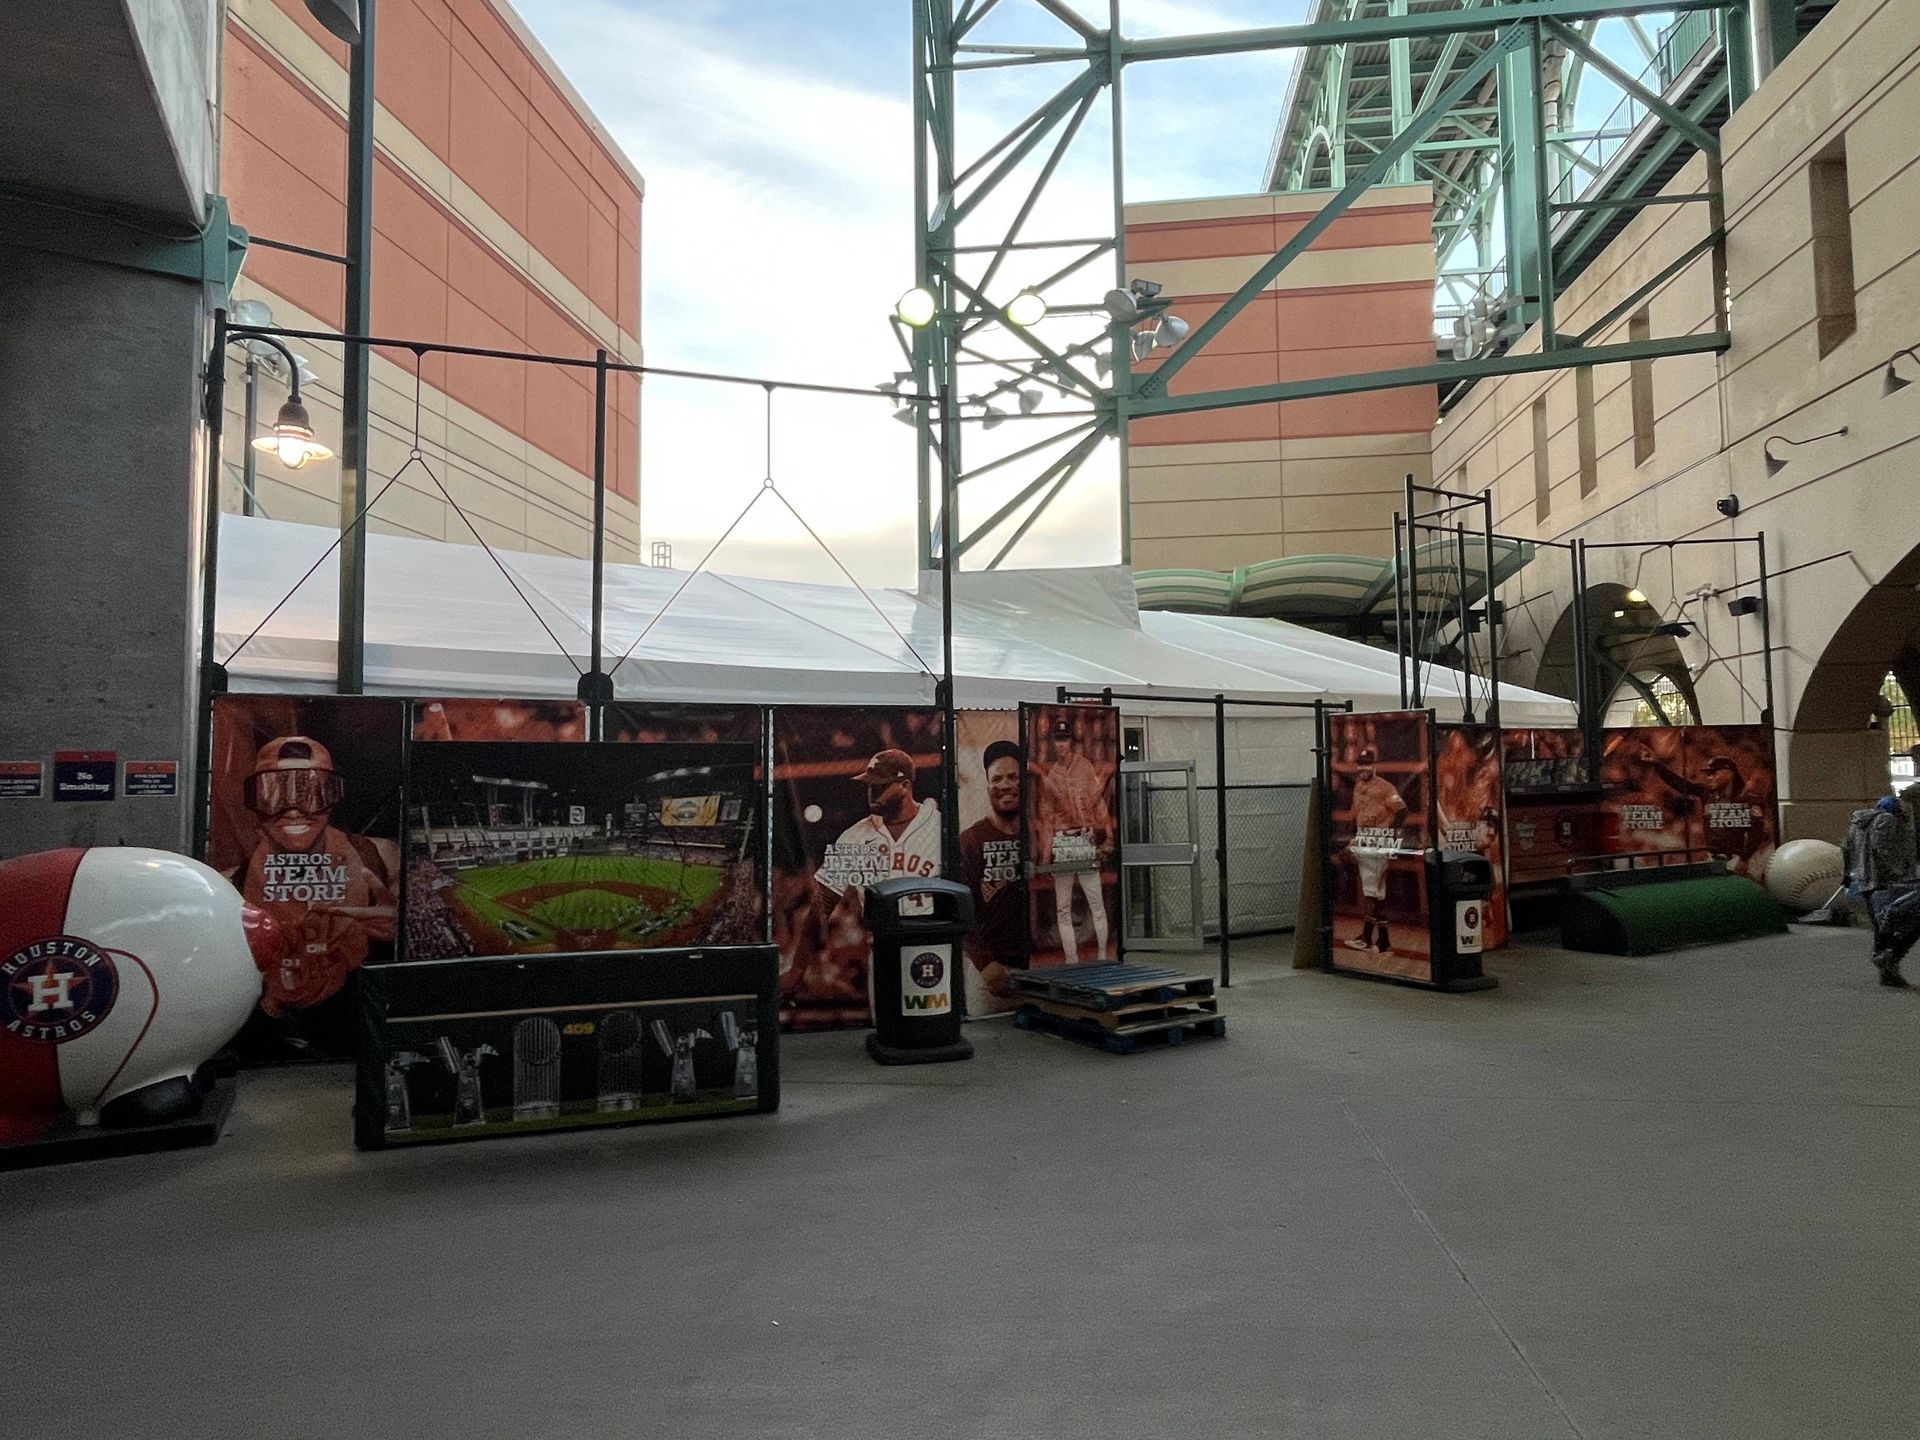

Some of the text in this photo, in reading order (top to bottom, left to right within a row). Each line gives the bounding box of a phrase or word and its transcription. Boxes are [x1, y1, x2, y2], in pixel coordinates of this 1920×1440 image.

[76, 772, 93, 780] No
[59, 783, 110, 792] Smoking
[1623, 811, 1663, 821] TEAM
[1709, 809, 1750, 819] TEAM
[1623, 820, 1664, 829] STORE
[1710, 818, 1751, 828] STORE
[1356, 827, 1395, 836] ASTROS
[824, 844, 877, 855] ASTROS
[983, 840, 1020, 851] ASTRO
[1355, 836, 1403, 850] TEAM
[265, 853, 332, 866] ASTROS
[823, 855, 889, 871] TEAM
[983, 852, 1020, 867] TEA
[263, 865, 348, 884] TEAM
[983, 866, 1020, 882] STO
[263, 884, 346, 902] STORE
[2, 941, 101, 975] HOUSTON
[27, 972, 74, 1012] H
[904, 993, 949, 1010] WM
[7, 1011, 96, 1039] ASTROS
